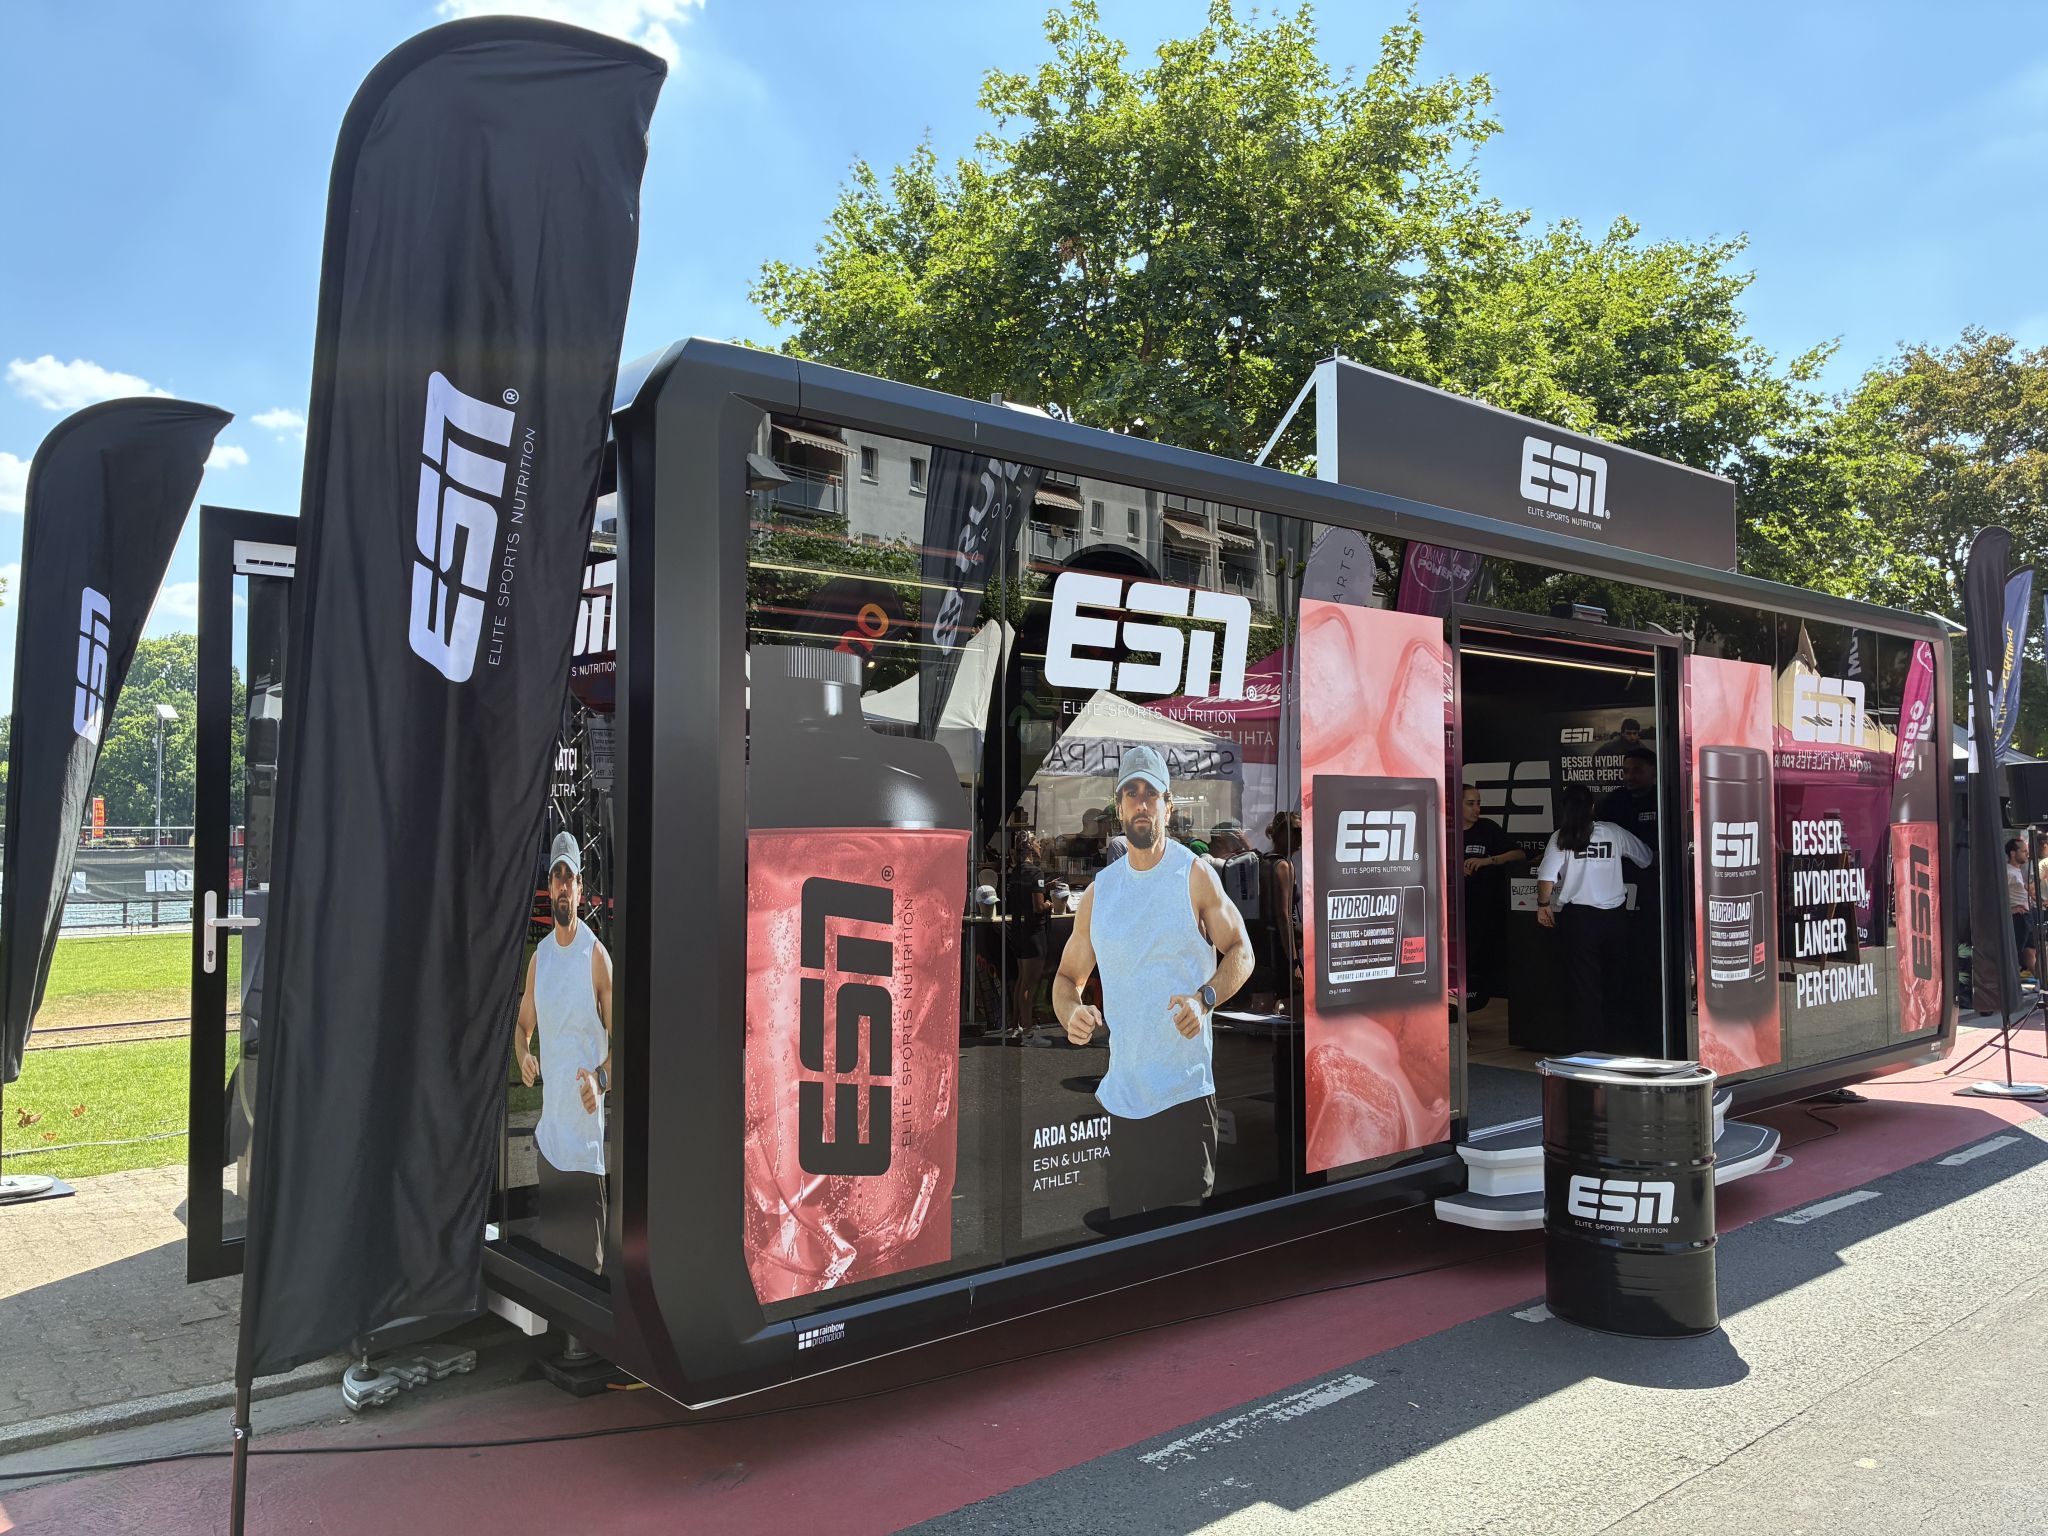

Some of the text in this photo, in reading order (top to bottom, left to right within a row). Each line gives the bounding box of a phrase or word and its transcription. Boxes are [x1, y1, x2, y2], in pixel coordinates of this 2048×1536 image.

[1527, 505, 1602, 531] ELITE SPORTS NUTRITION
[488, 426, 536, 666] ELITE SPORTS NUTRITION
[1062, 700, 1237, 724] ELITE SPORTS NUTRITION
[1561, 755, 1593, 769] BESSER
[1562, 767, 1594, 782] LÄNGER
[1792, 820, 1843, 856] BESSER
[1342, 865, 1411, 875] ELITE SPORTS NUTRITION
[1724, 870, 1739, 878] SPORTS
[1329, 894, 1397, 920] HYDROLOAD
[1710, 901, 1750, 923] HYDROLOAD
[1794, 913, 1847, 958] LÄNGER
[1796, 962, 1878, 1009] PERFORMEN.
[902, 898, 914, 1148] ELITE SPORTS NUTRITION
[1033, 1115, 1112, 1150] ARDA SAATÇI
[1033, 1145, 1111, 1172] ESN & ULTRA
[1032, 1170, 1080, 1192] ATHLET
[1574, 1219, 1669, 1234] ELITE SPORTS NUTRITION
[812, 1330, 846, 1348] promotion
[819, 1322, 846, 1336] rainbow
